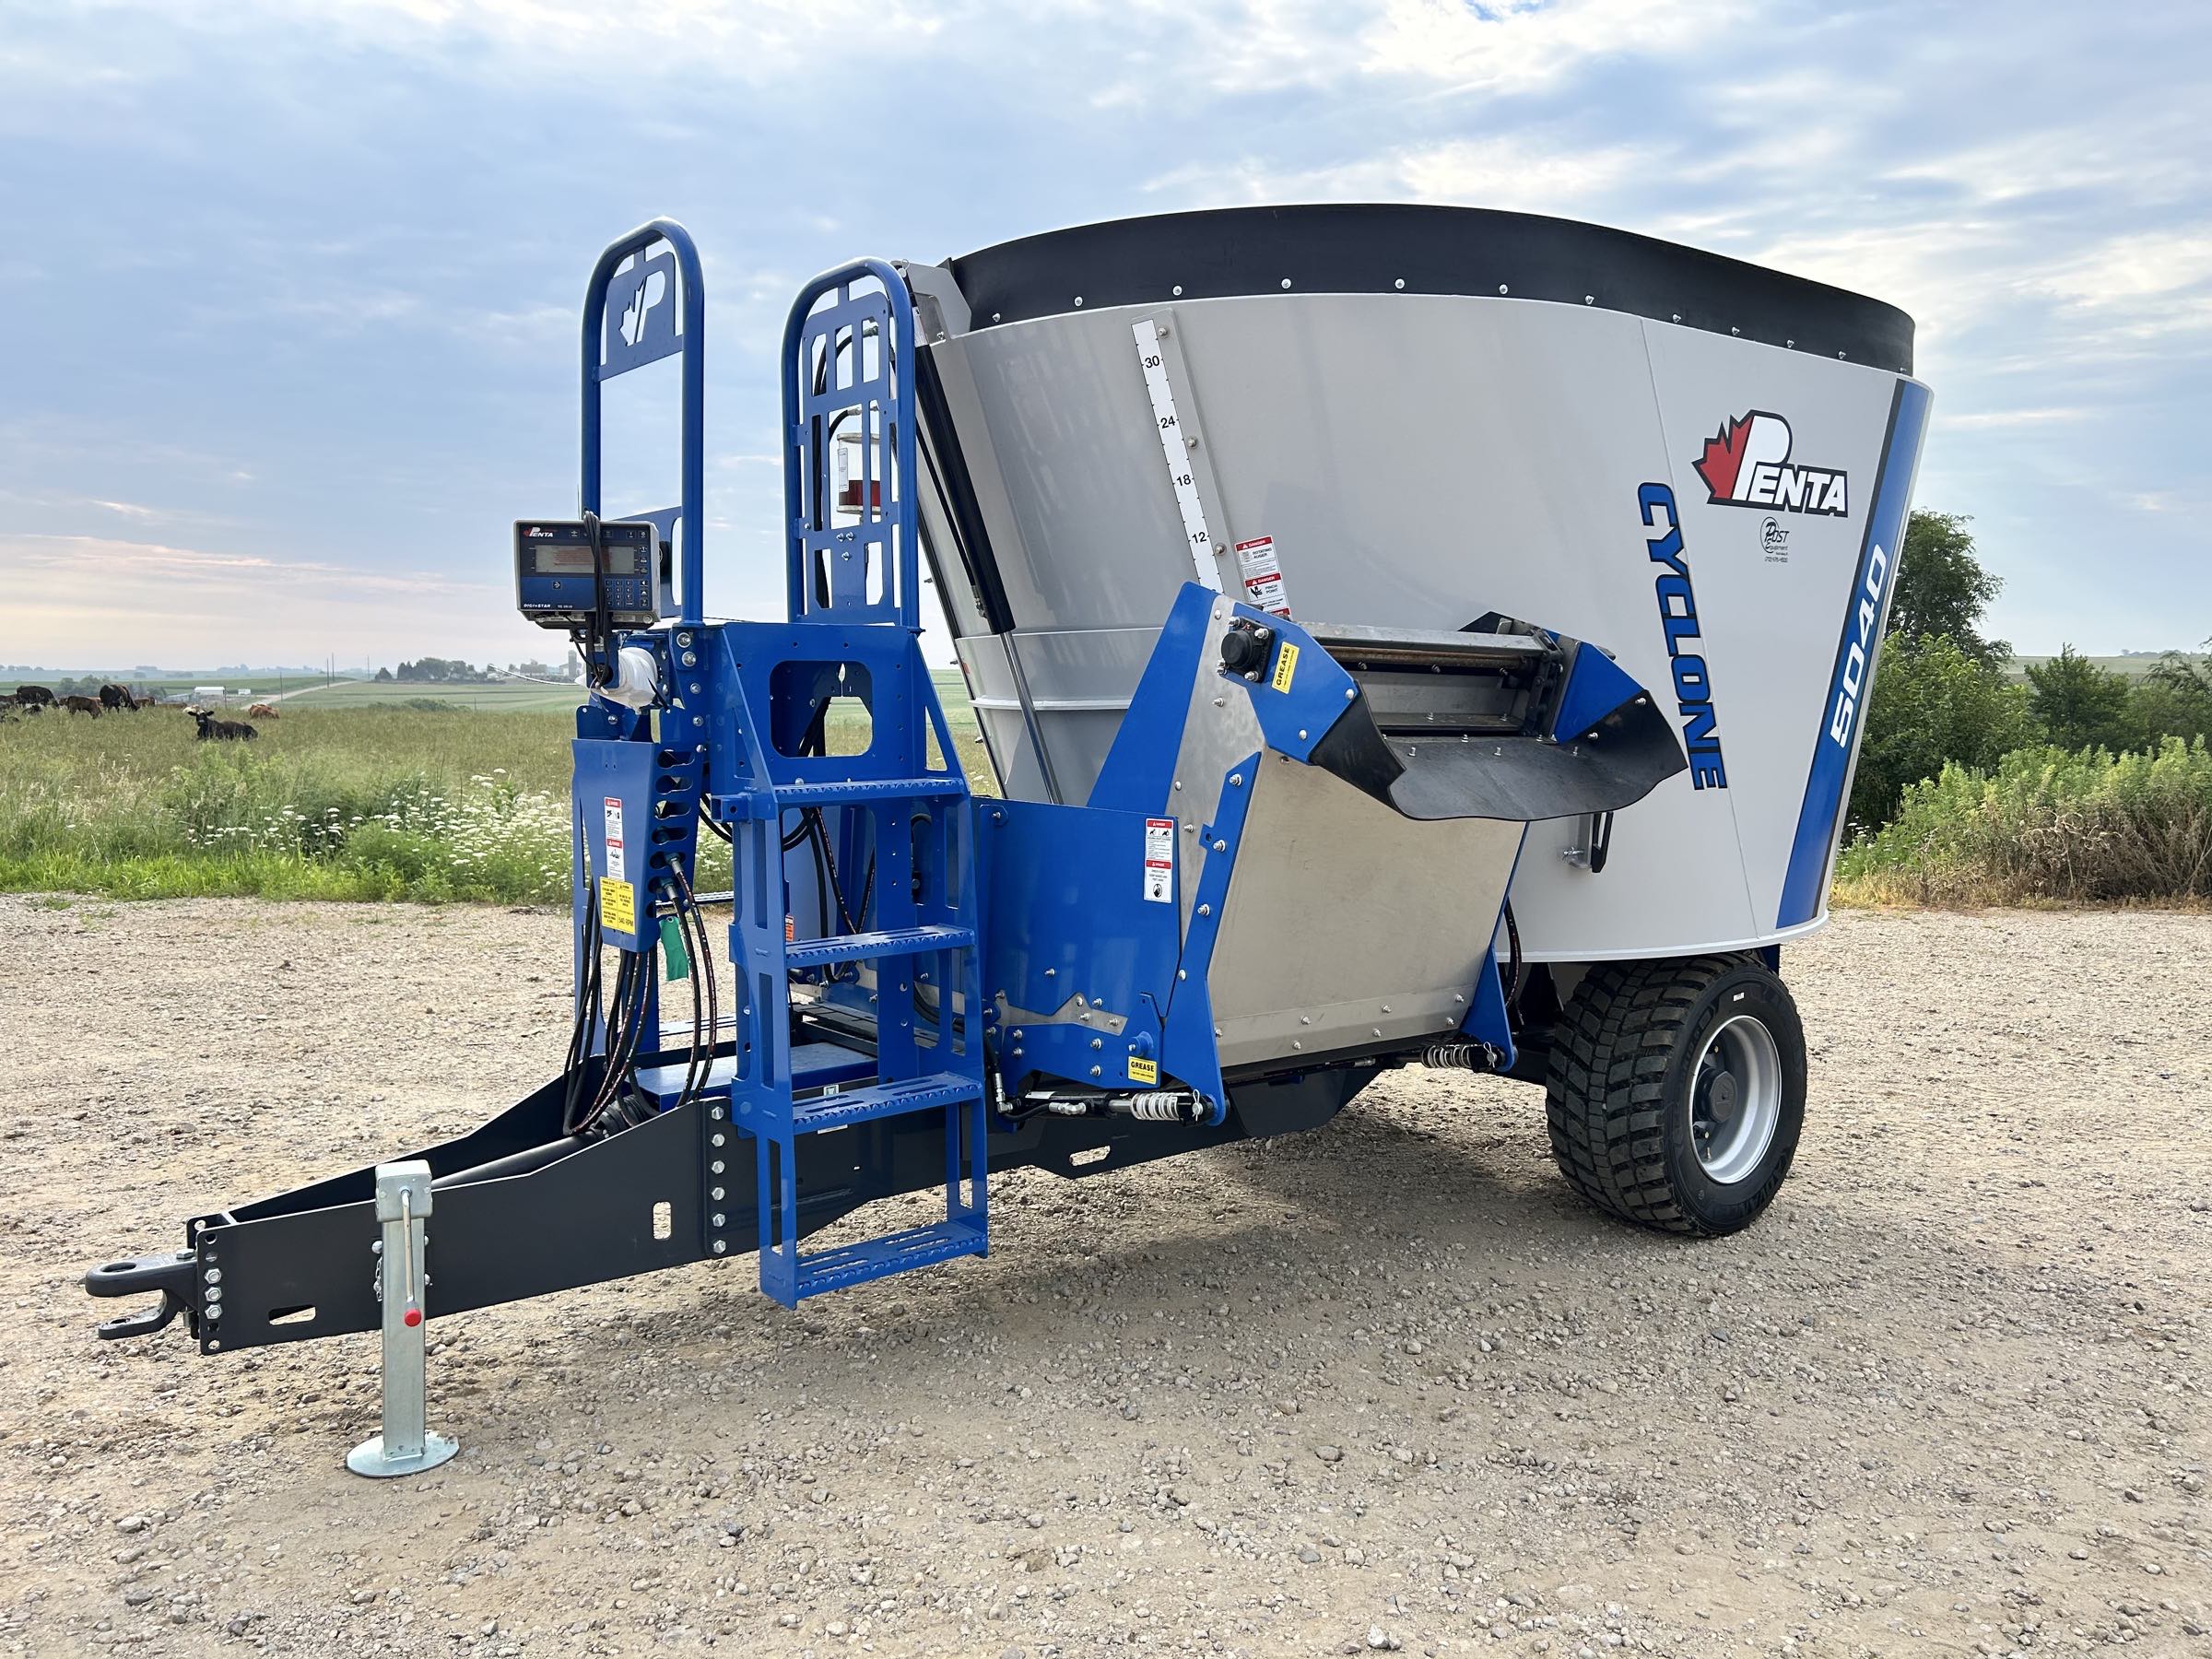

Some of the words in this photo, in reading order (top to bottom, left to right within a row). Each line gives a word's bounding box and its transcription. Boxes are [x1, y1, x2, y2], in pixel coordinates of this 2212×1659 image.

[1144, 355, 1160, 369] 30
[1159, 416, 1176, 429] 24
[1731, 413, 1847, 514] PENTA
[1176, 474, 1192, 487] 18
[529, 526, 554, 537] PENTA
[1191, 532, 1207, 544] 12
[1764, 521, 1790, 543] POST
[1637, 482, 1727, 790] CYCLONE
[1830, 544, 1887, 748] 5040
[1276, 646, 1290, 687] GREASE
[1131, 1061, 1154, 1072] GREASE
